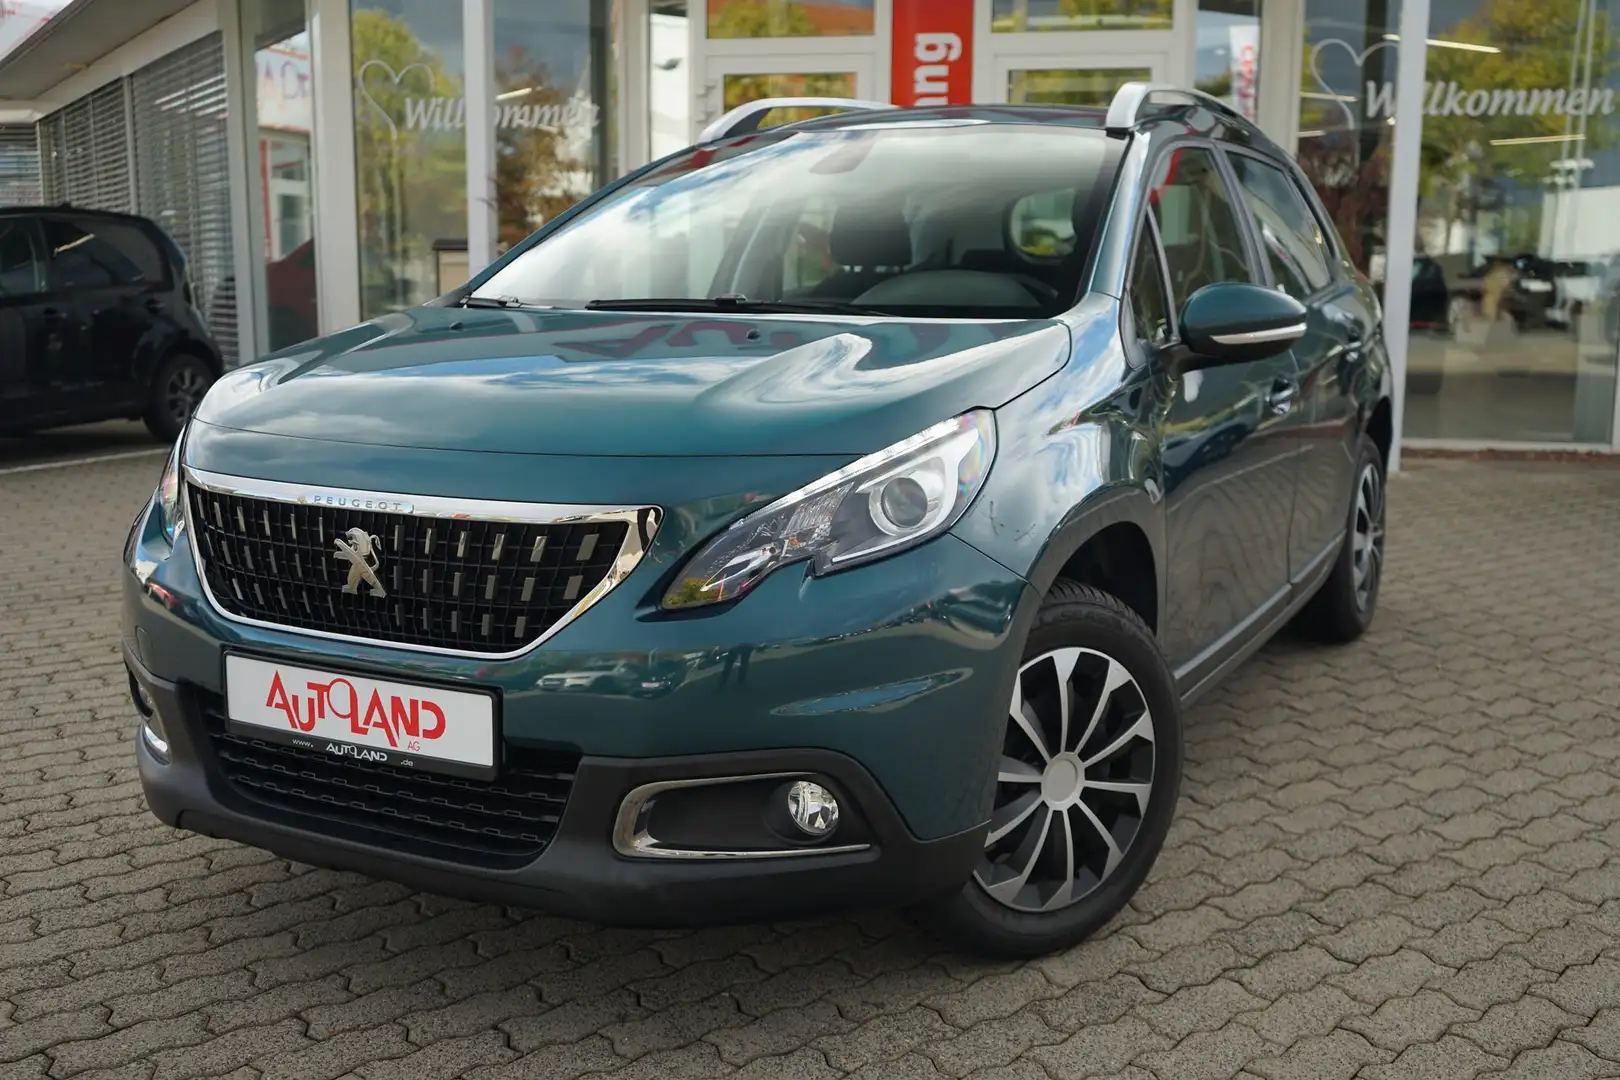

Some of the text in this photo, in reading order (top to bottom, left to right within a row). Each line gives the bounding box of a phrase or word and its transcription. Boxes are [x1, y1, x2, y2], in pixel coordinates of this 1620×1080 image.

[314, 495, 402, 510] PEUGEOT
[292, 738, 314, 748] www.
[400, 758, 414, 767] .de
[407, 740, 420, 752] AG
